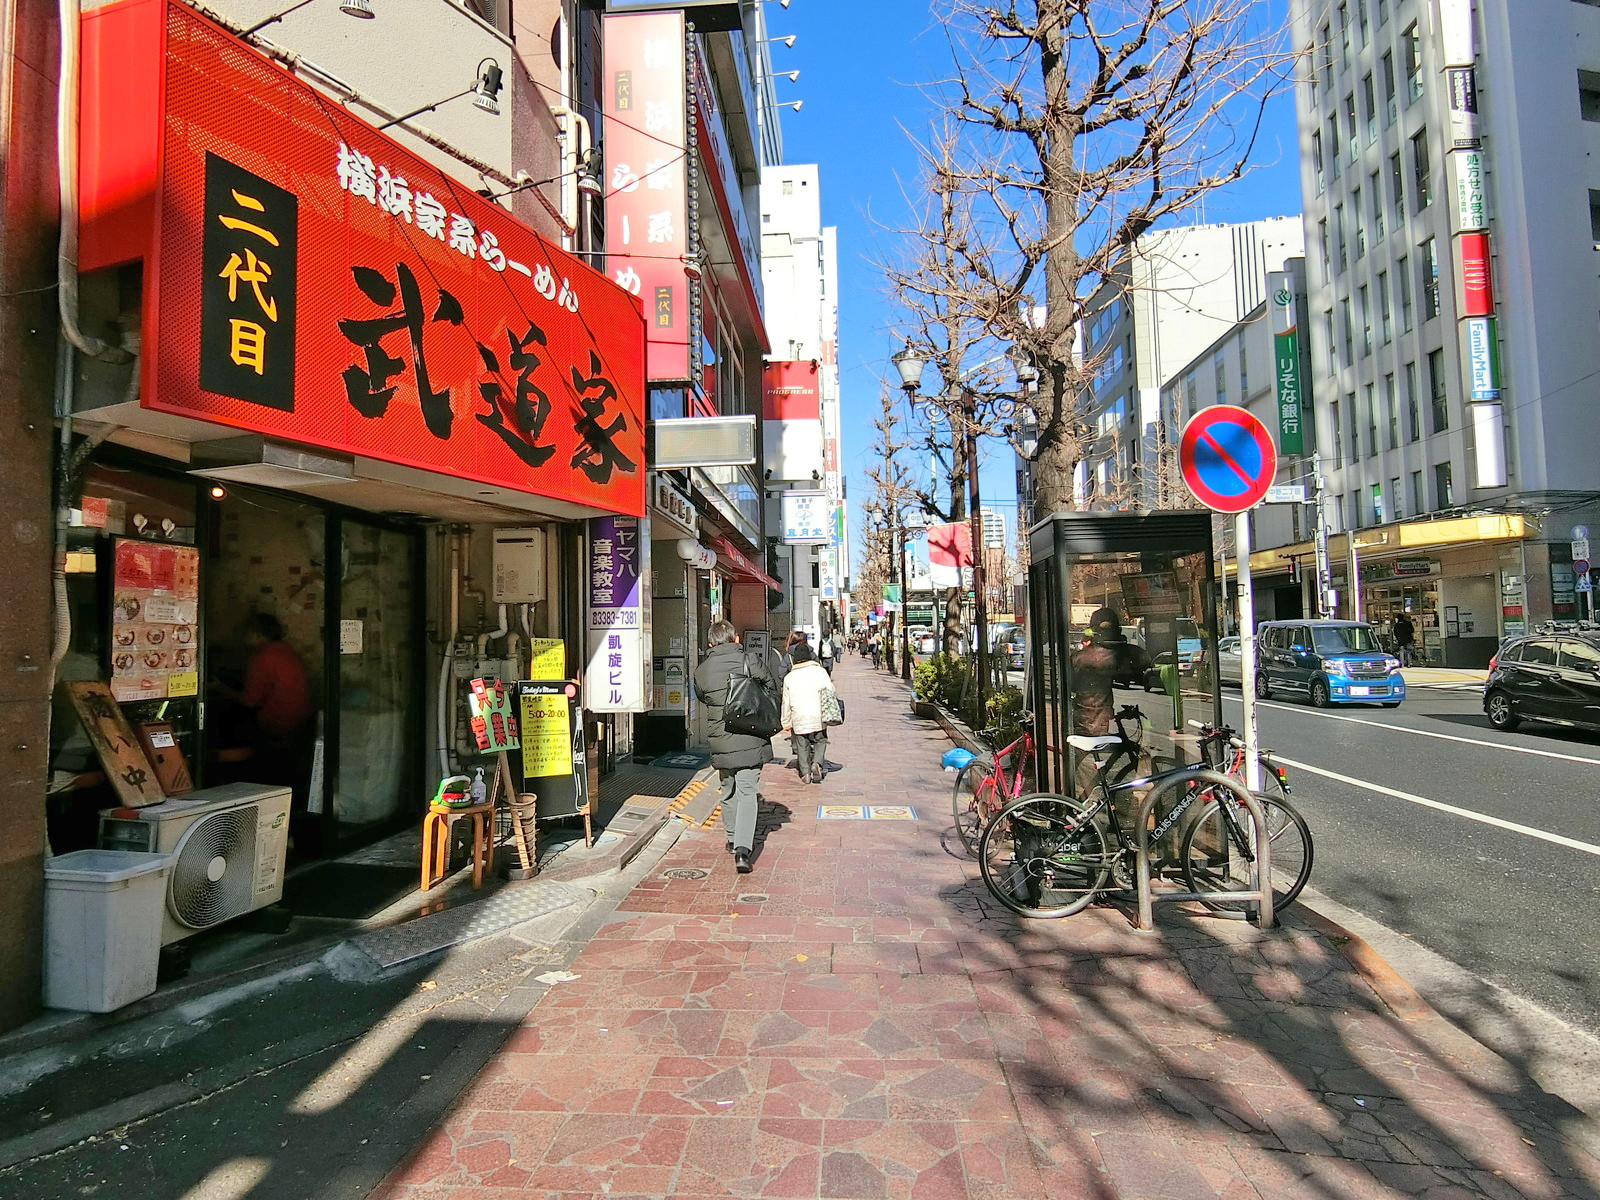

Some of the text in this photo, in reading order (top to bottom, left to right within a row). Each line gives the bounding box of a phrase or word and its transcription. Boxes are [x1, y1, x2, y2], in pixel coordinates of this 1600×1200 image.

[617, 73, 630, 109] 二代目
[1466, 154, 1483, 227] 処方せん受付
[335, 141, 580, 313] 横浜家系らーめん
[217, 188, 280, 377] 二代目
[658, 288, 670, 326] 二代目
[337, 262, 638, 485] 武道家
[1471, 322, 1487, 389] FamilyMart
[1280, 358, 1299, 434] りそな銀行
[1268, 487, 1301, 496] 中野二丁目
[593, 538, 614, 605] 音楽教室
[616, 530, 636, 578] ヤマハ
[597, 611, 637, 626] 3383-7381
[470, 678, 505, 711] 只今
[608, 635, 622, 705] 凱旋ビル
[470, 711, 518, 750] 営業中
[1151, 819, 1171, 841] LOUIS
